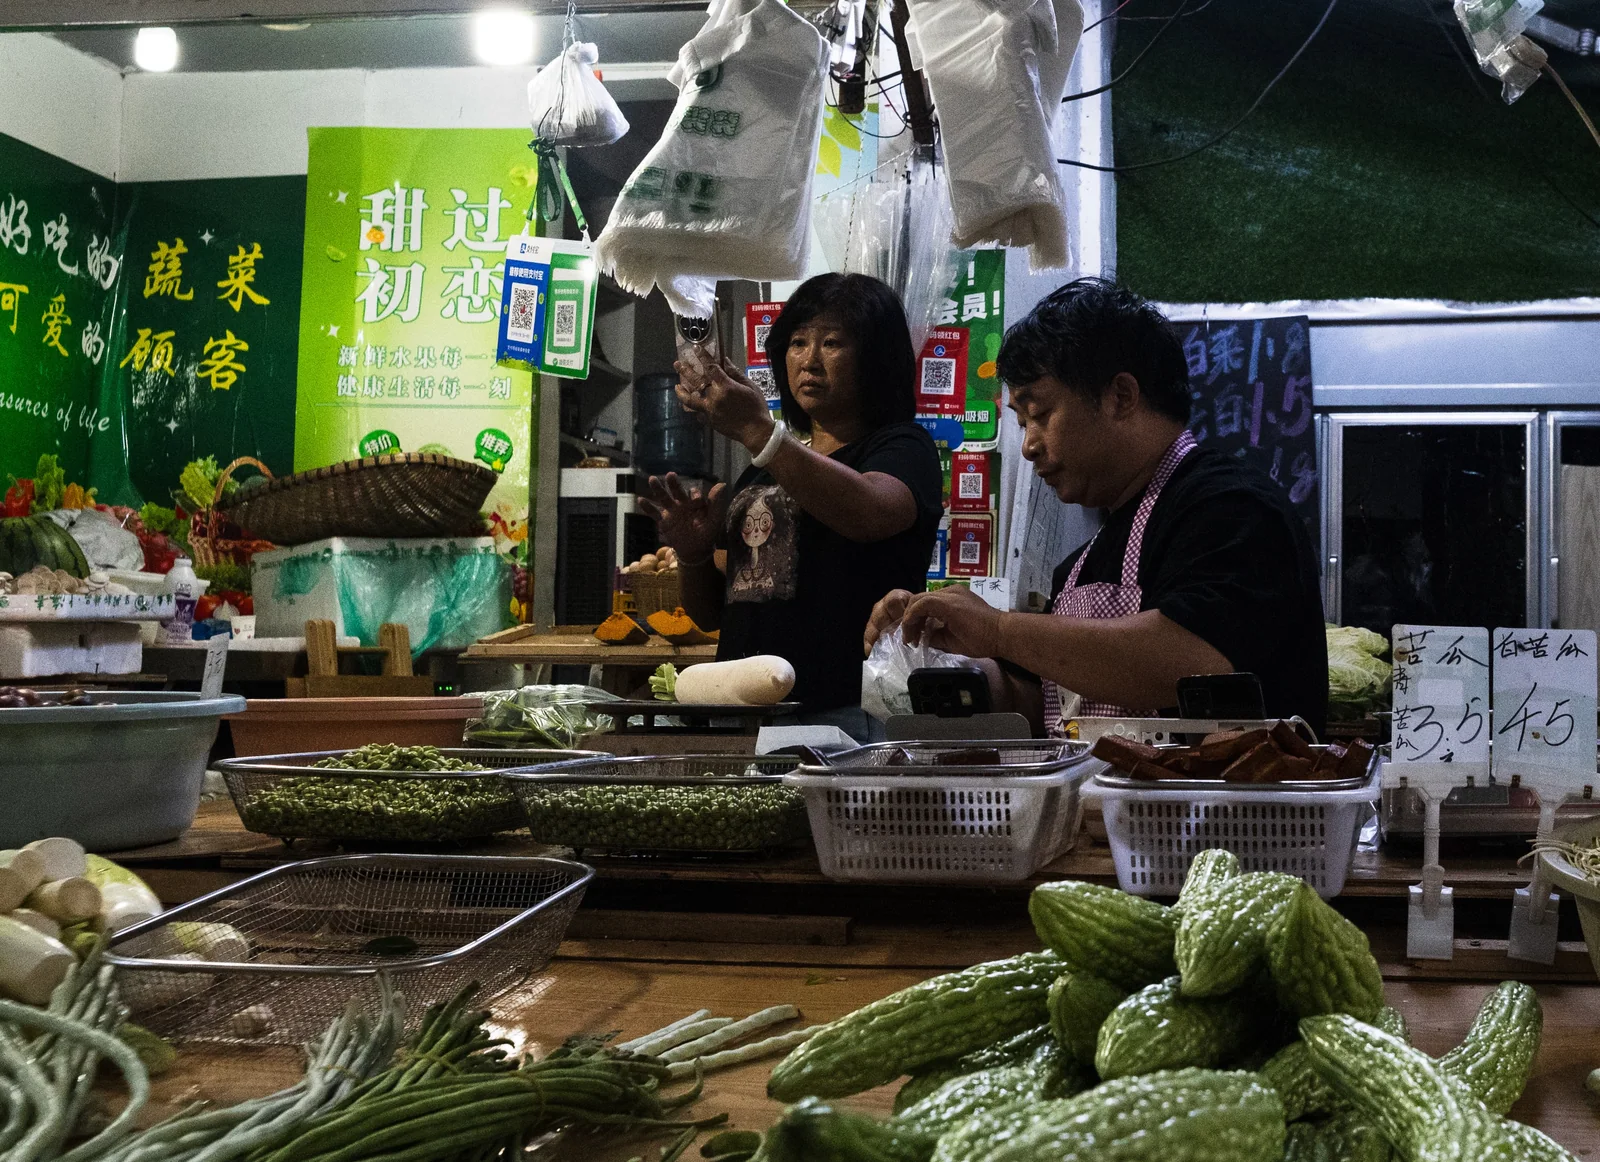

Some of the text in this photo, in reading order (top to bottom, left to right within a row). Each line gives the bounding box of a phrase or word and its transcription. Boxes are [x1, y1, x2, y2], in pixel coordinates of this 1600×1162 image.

[359, 187, 512, 252] 甜过
[143, 237, 270, 312] 蔬菜
[120, 328, 249, 391] 顾客
[337, 344, 498, 370] 新鲜水果每一
[336, 374, 511, 400] 健康生活每一刻
[56, 401, 73, 432] of
[79, 405, 110, 437] life
[364, 433, 393, 455] 特价
[480, 432, 510, 456] 推荐
[1398, 630, 1489, 667] 苦瓜
